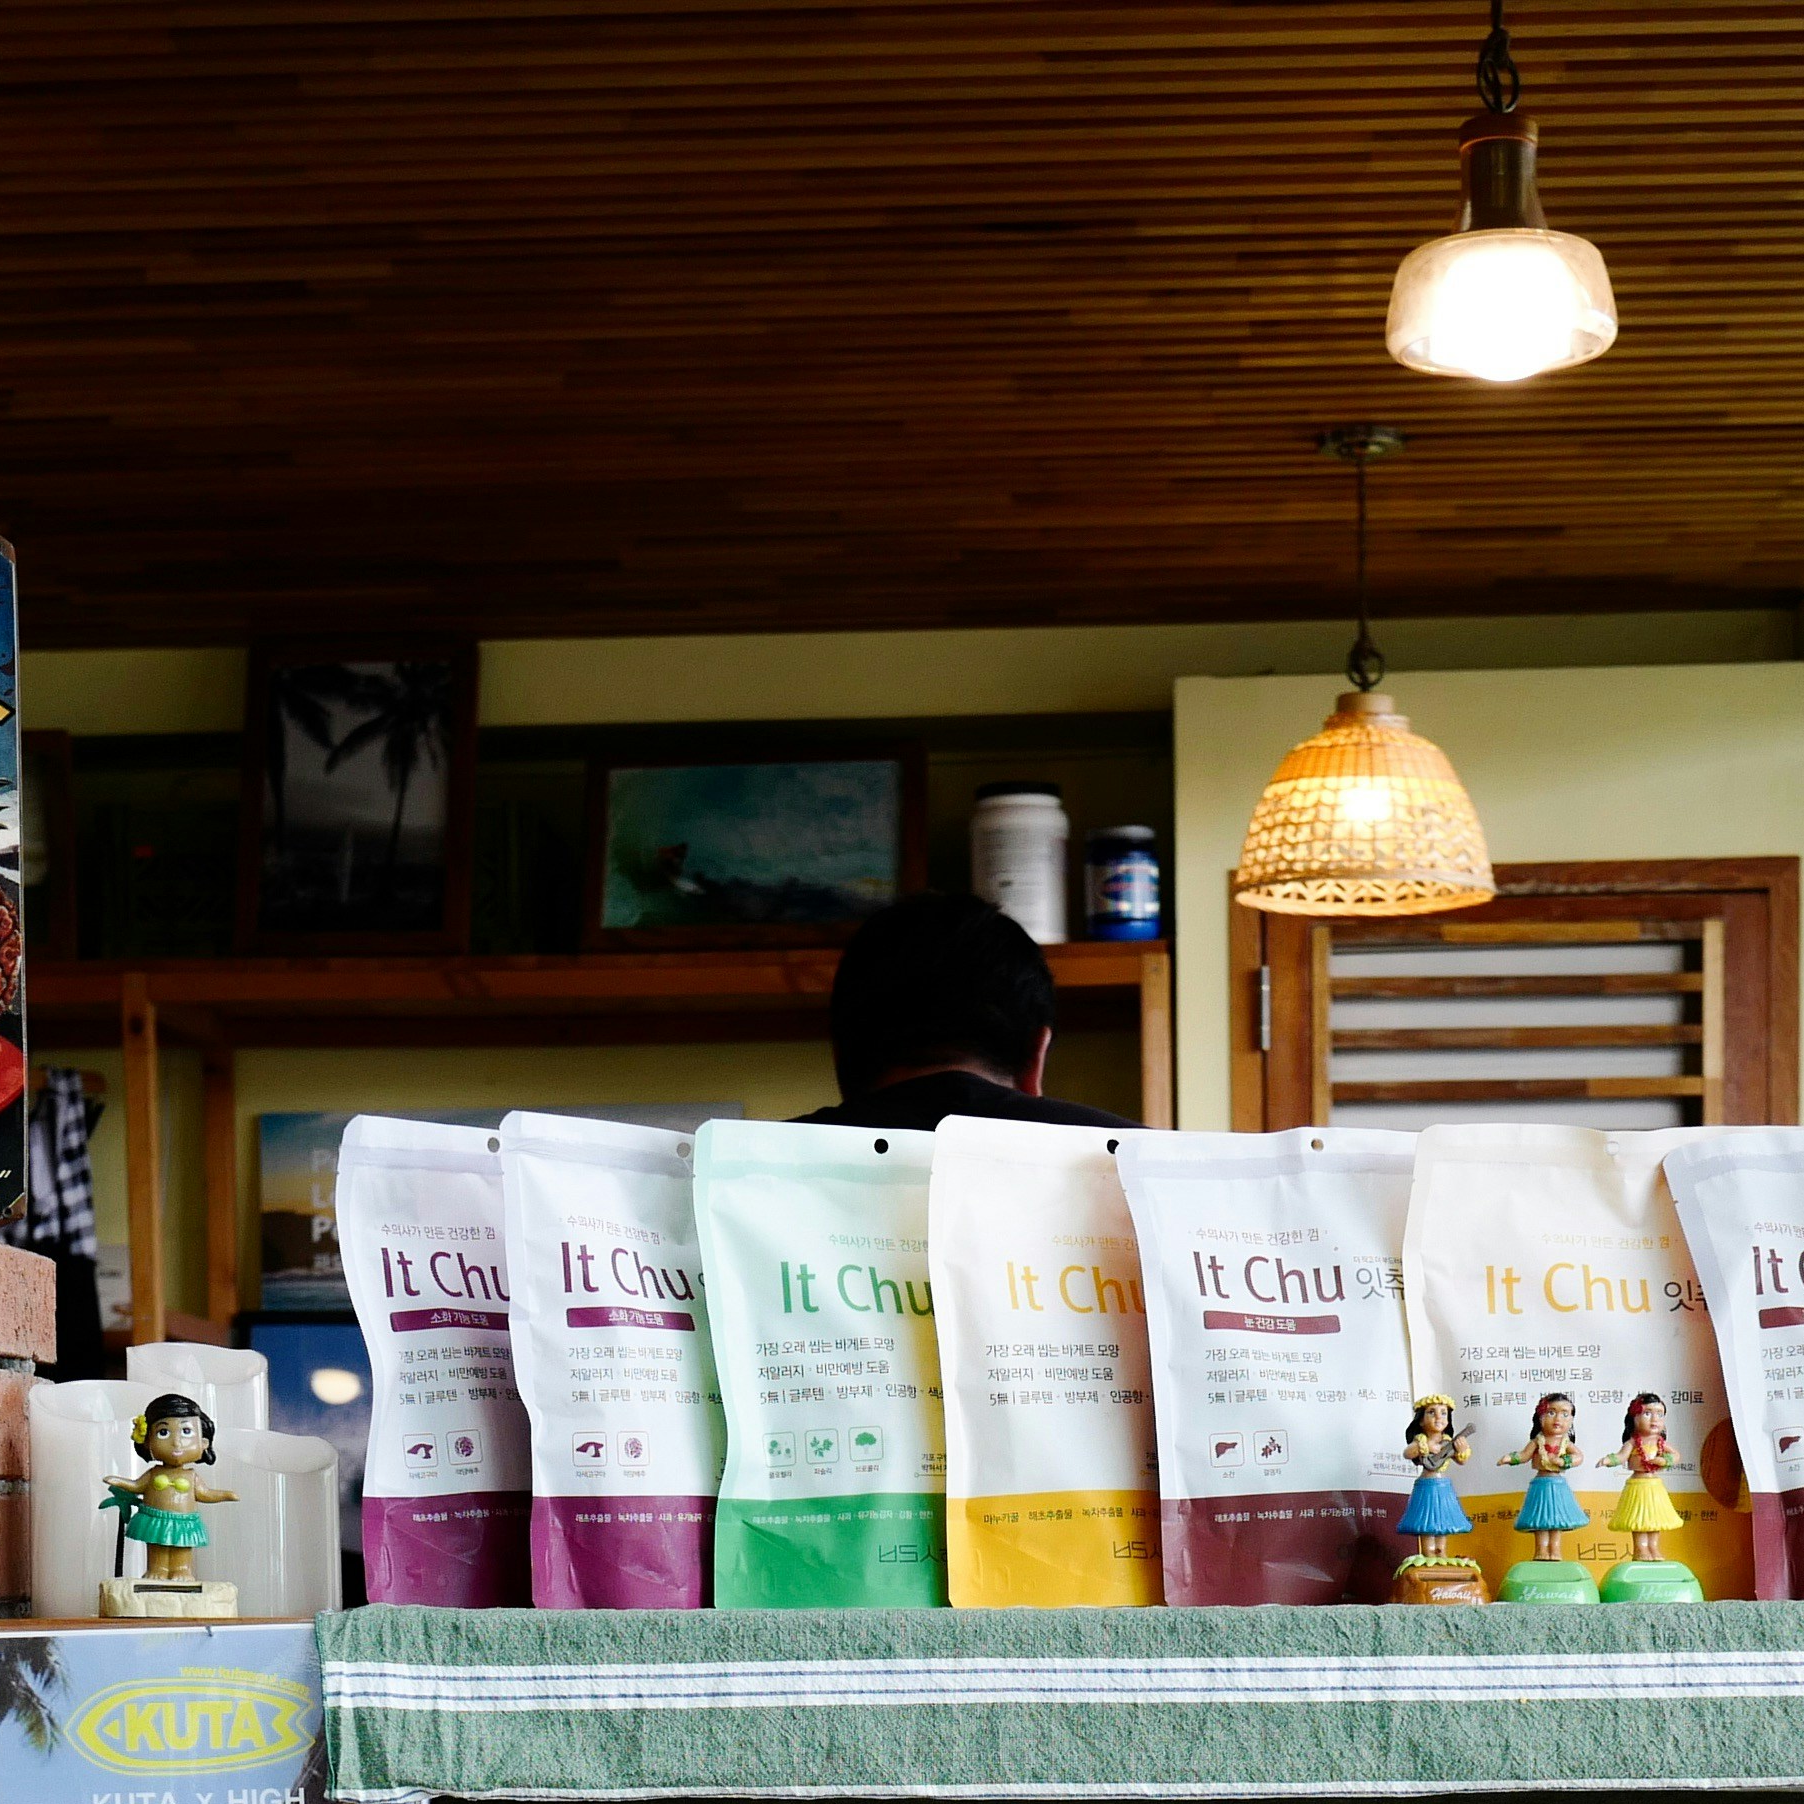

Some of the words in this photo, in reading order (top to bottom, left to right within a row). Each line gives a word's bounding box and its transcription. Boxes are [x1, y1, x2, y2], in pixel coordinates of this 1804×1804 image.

[381, 1223, 421, 1237] 수의사가
[425, 1227, 444, 1240] 만든
[448, 1227, 480, 1240] 건강한
[485, 1227, 495, 1239] 껌
[1196, 1228, 1239, 1242] 수의사가
[1242, 1232, 1263, 1245] 만든
[1267, 1230, 1303, 1246] 건강한
[1308, 1228, 1319, 1241] 껌
[381, 1247, 420, 1297] It
[562, 1242, 599, 1292] It
[611, 1248, 695, 1300] Chu
[1193, 1251, 1230, 1299] It
[1245, 1256, 1346, 1303] Chu
[1752, 1246, 1788, 1295] It
[781, 1262, 819, 1313] It
[837, 1264, 935, 1316] Chu
[1007, 1261, 1043, 1311] It
[1486, 1266, 1523, 1315] It
[1544, 1262, 1651, 1314] Chu
[1256, 1317, 1274, 1330] 건강
[1277, 1319, 1296, 1330] 도움
[569, 1347, 590, 1360] 가장
[593, 1347, 614, 1359] 오래
[756, 1343, 779, 1356] 가장
[782, 1341, 805, 1353] 오래
[809, 1340, 832, 1353] 씹는
[875, 1338, 895, 1351] 모양
[986, 1345, 1008, 1358] 가장
[1012, 1345, 1034, 1356] 오래
[1038, 1345, 1060, 1358] 씹는
[1063, 1345, 1095, 1357] 바게트
[1098, 1345, 1119, 1358] 모양
[1487, 1346, 1509, 1359] 오래
[1513, 1346, 1536, 1359] 씹는
[1578, 1345, 1601, 1358] 모양
[758, 1365, 804, 1380] 저알러지
[817, 1362, 863, 1375] 비만예방
[867, 1361, 890, 1374] 도움
[988, 1368, 1033, 1382] 저알러지
[1045, 1369, 1088, 1381] 비만예방
[1092, 1368, 1113, 1381] 도움
[1207, 1370, 1249, 1382] 저알러지
[1299, 1372, 1318, 1383] 도움
[1461, 1371, 1508, 1383] 저알러지
[1570, 1369, 1593, 1381] 도움
[1019, 1392, 1053, 1404] 글루텐
[1065, 1391, 1099, 1404] 방부제
[1110, 1390, 1143, 1404] 인공향
[1492, 1392, 1527, 1406] 글루텐
[1589, 1391, 1623, 1404] 인공향
[1671, 1391, 1704, 1405] 감미료
[1430, 1587, 1471, 1600] Hawaii
[1520, 1586, 1585, 1601] Hawaii
[125, 1701, 267, 1751] KUTA
